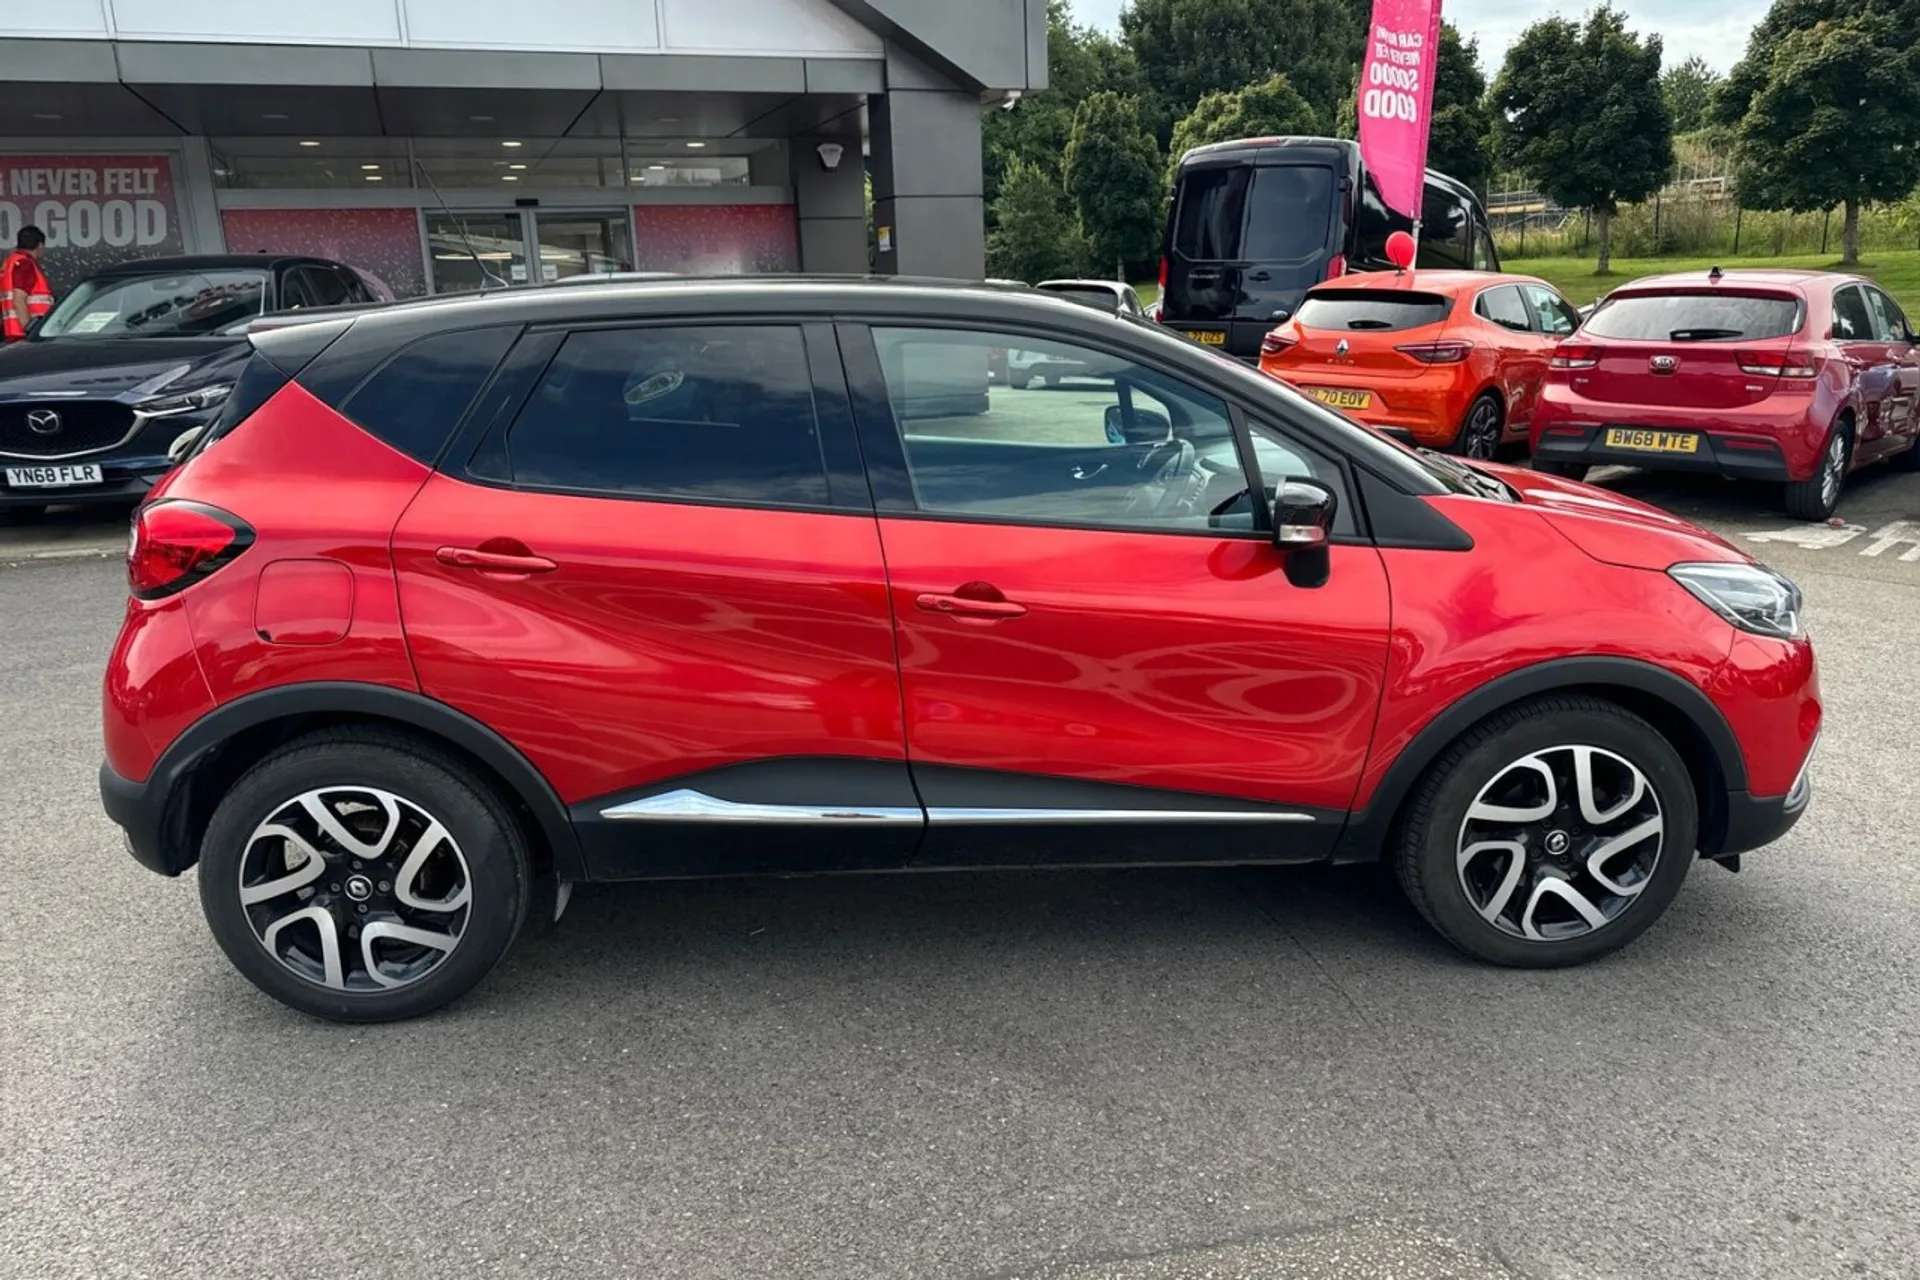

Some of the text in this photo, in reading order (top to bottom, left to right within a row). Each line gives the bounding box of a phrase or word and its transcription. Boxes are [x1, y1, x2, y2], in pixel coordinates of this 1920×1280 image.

[10, 168, 98, 196] NEVER
[103, 168, 159, 195] FELT
[33, 199, 168, 248] GOOD
[1612, 430, 1690, 450] BW68 WTE
[12, 465, 96, 483] YN68 FLR
